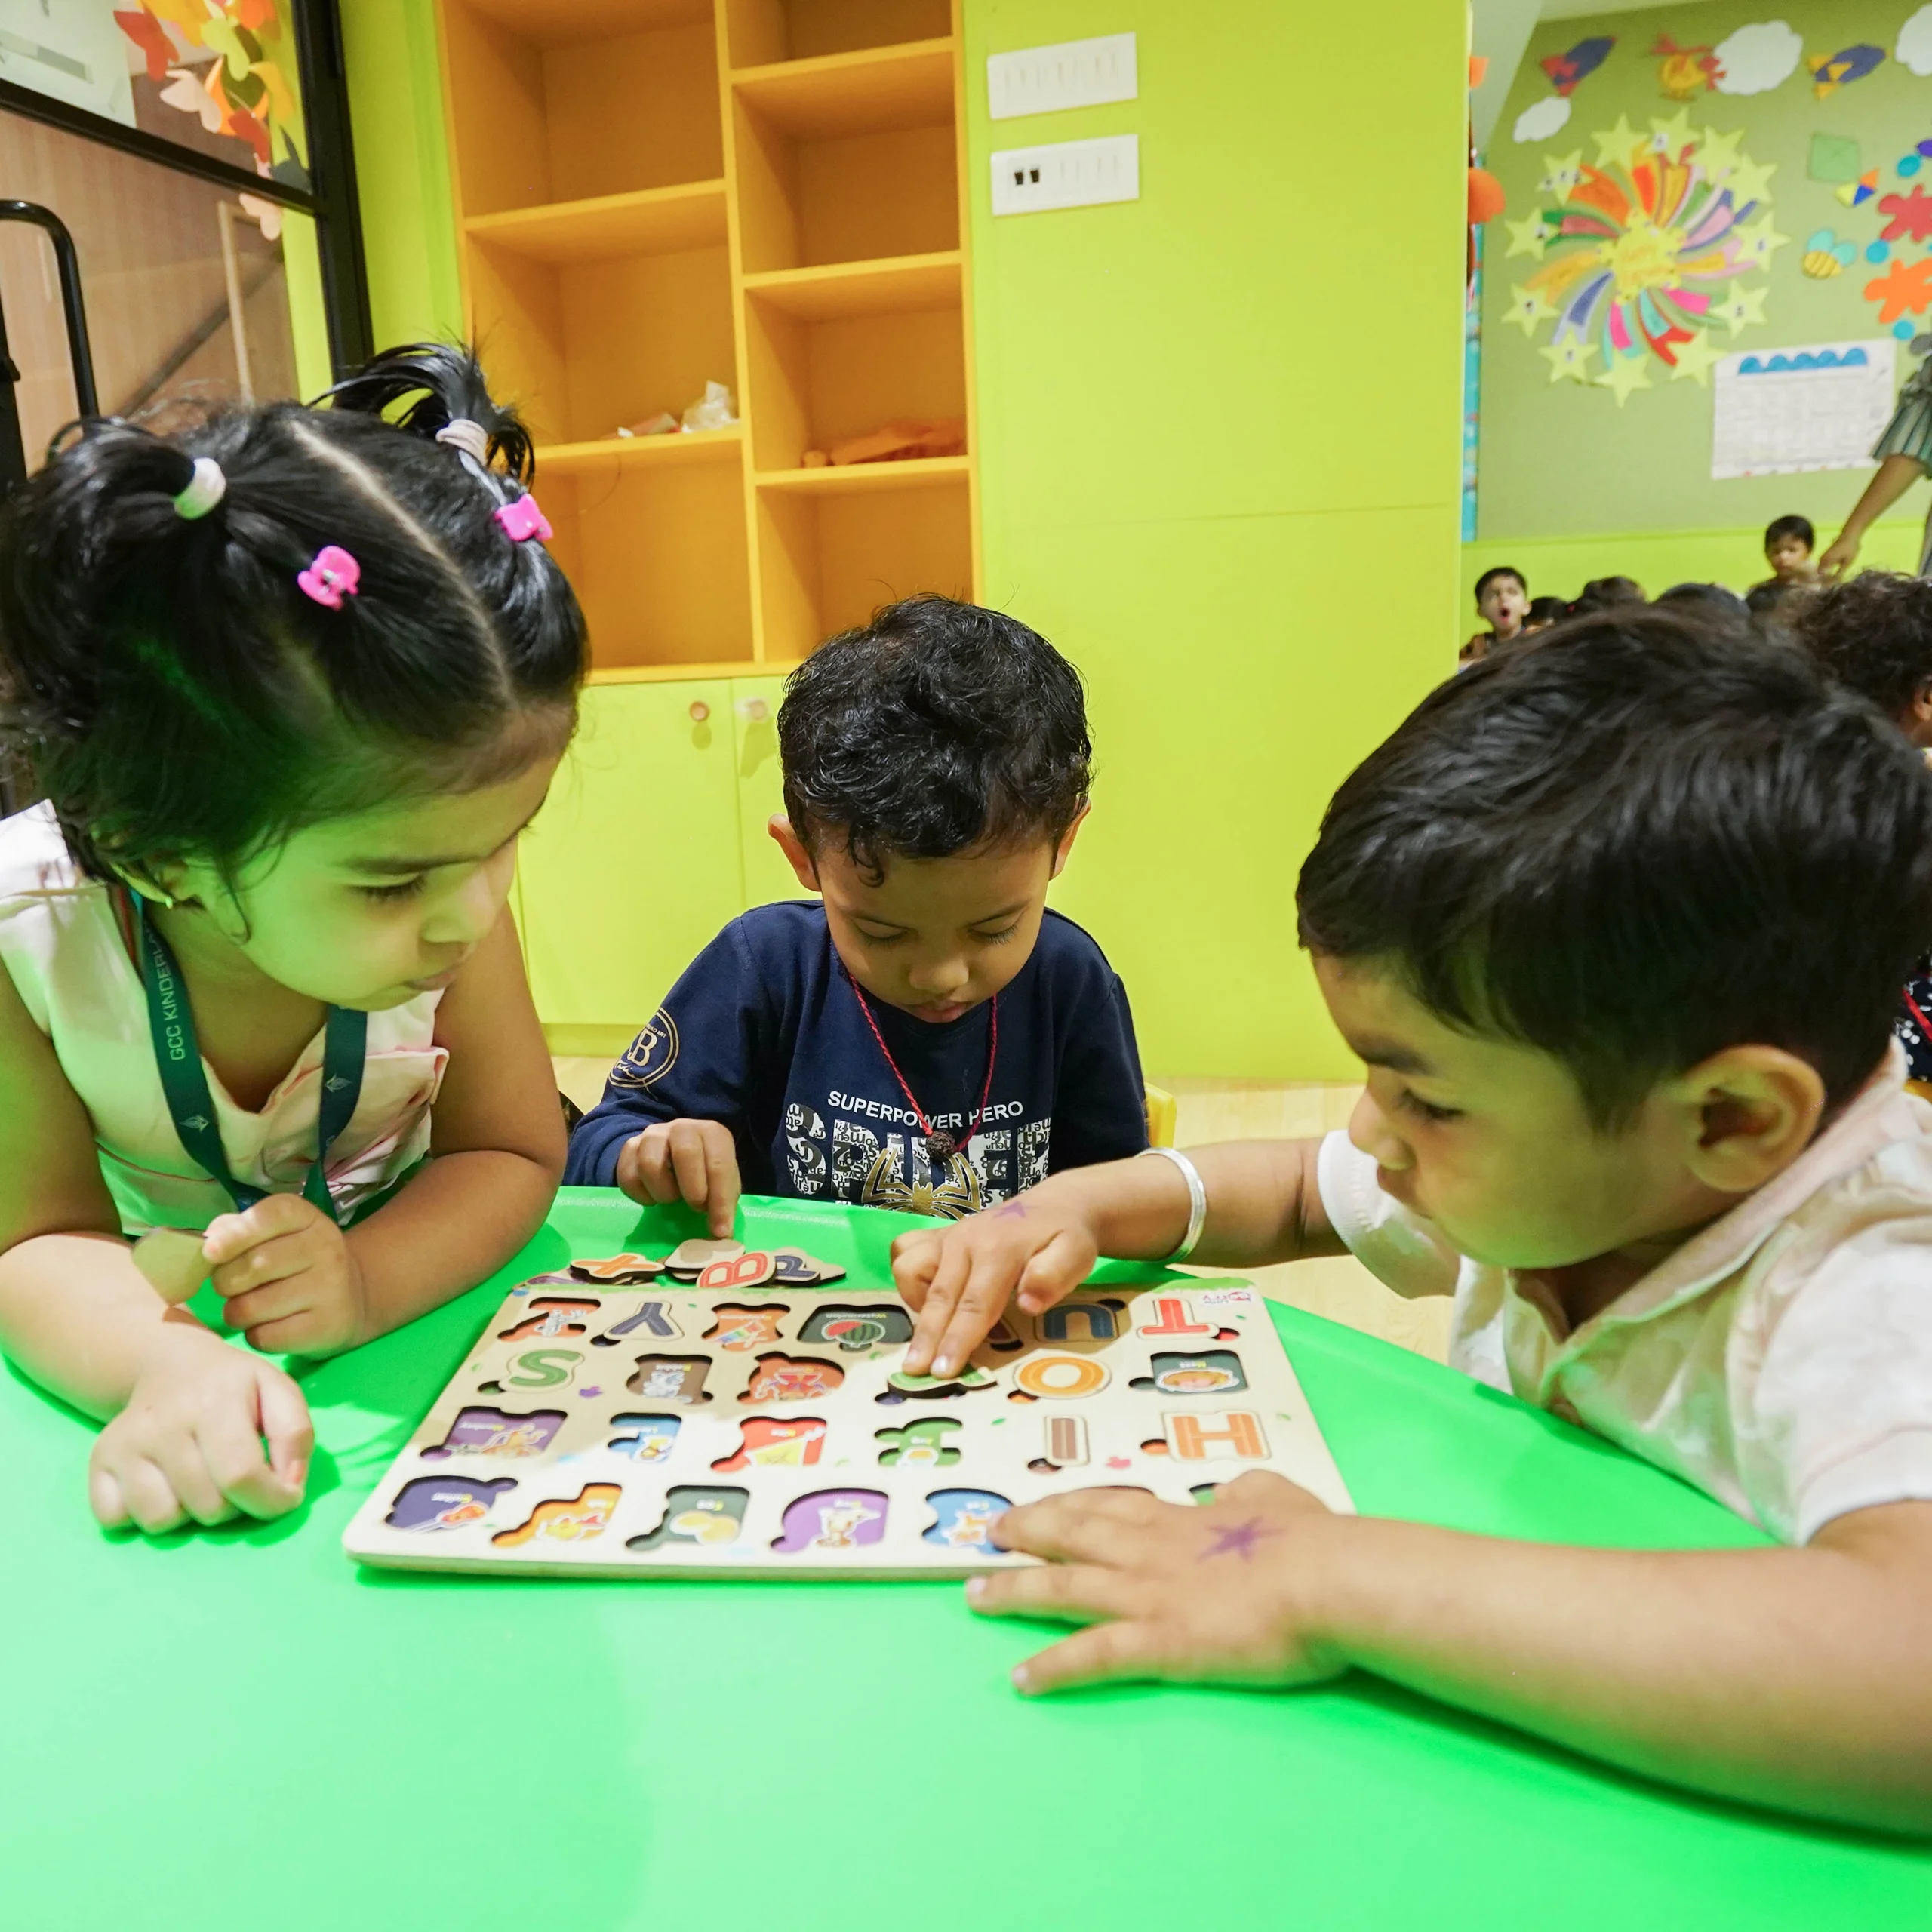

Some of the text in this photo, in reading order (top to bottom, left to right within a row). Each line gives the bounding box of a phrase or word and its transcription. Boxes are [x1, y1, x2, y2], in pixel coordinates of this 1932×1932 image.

[166, 1025, 186, 1060] GCC
[828, 1091, 1023, 1129] SUPERPOWER HERO
[700, 1252, 768, 1287] B
[611, 1302, 674, 1337] Y
[1044, 1304, 1113, 1340] U
[1142, 1299, 1211, 1335] T
[509, 1350, 583, 1387] S
[1019, 1356, 1105, 1389] O
[1173, 1414, 1263, 1460] H
